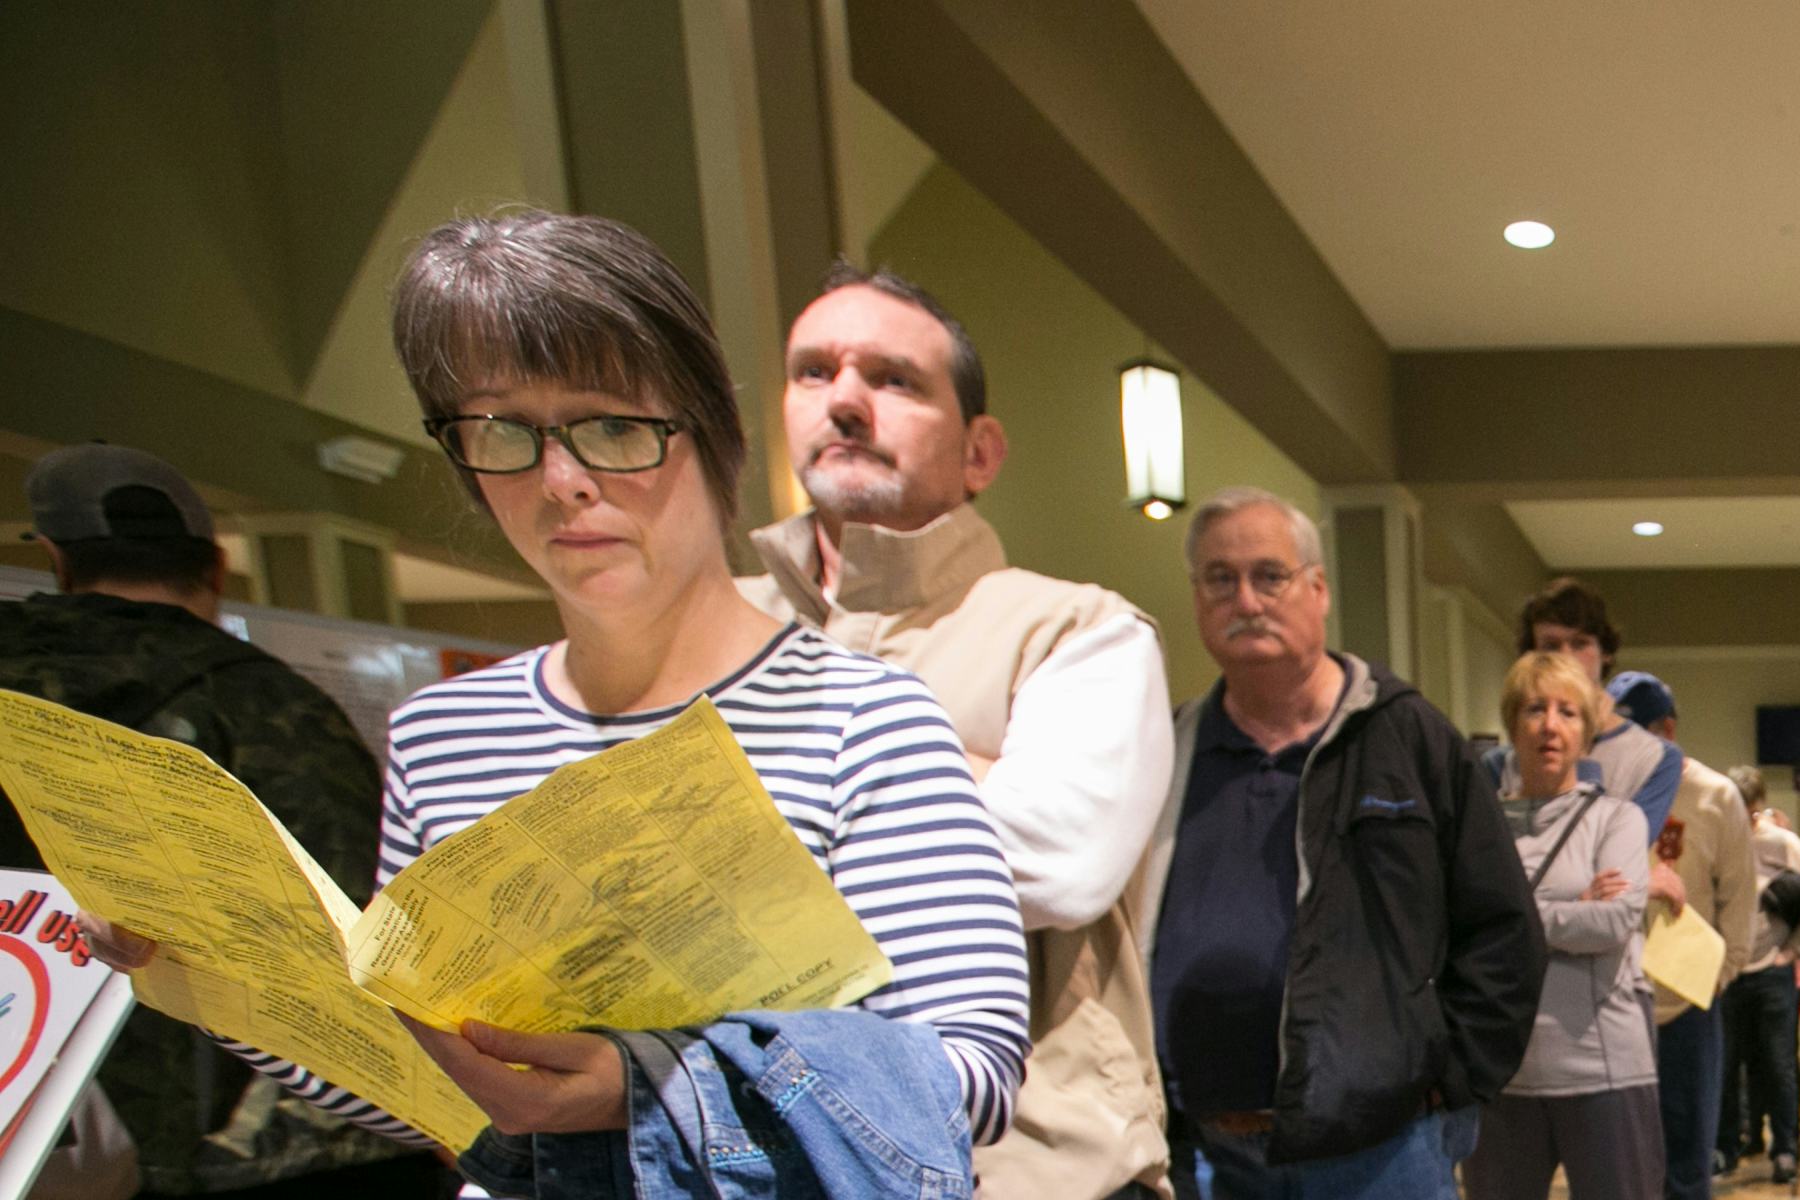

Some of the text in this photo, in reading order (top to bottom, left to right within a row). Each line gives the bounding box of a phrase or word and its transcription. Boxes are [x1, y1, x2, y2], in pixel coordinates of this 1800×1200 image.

[370, 910, 404, 968] Representative
[404, 887, 414, 901] the
[374, 905, 397, 941] For State
[383, 956, 397, 977] From
[394, 941, 405, 955] the
[412, 895, 430, 923] District
[380, 936, 400, 967] General
[796, 957, 834, 984] COPY
